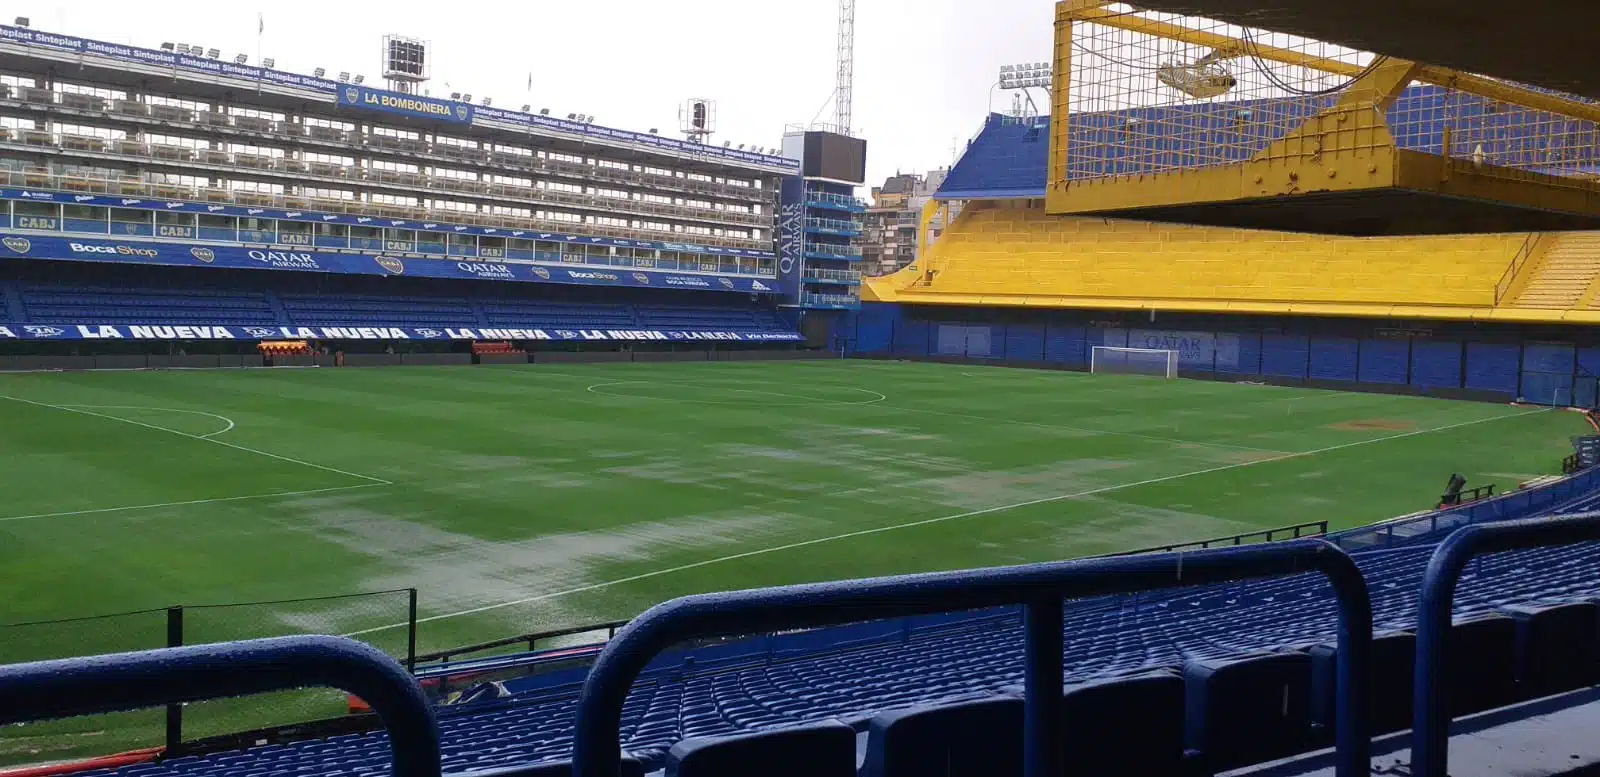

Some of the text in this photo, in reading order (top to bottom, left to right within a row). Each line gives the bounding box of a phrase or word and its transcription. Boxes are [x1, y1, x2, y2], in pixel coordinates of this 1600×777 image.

[35, 33, 82, 48] Sinteplast
[87, 42, 131, 55] Sinteplast
[133, 50, 176, 63] Sinteplast
[180, 57, 220, 70] Sinteplast
[222, 64, 260, 76] Sinteplast
[264, 71, 301, 83] Sinteplast
[302, 78, 337, 90] Sinteplast
[364, 92, 379, 105] LA
[381, 95, 451, 116] BOMBONERA
[20, 217, 56, 229] CABJ
[160, 225, 191, 237] CABJ
[792, 203, 801, 256] AIRWAYS
[281, 233, 309, 244] CABJ
[780, 203, 795, 274] QATAR
[387, 241, 411, 251] CABJ
[248, 250, 315, 263] QATAR
[481, 248, 502, 257] CABJ
[272, 260, 320, 269] AIRWAYS
[457, 261, 511, 273] QATAR
[76, 325, 236, 339] LA NUEVA
[279, 326, 319, 339] LA
[320, 326, 410, 339] NUEVA
[444, 328, 478, 339] LA
[478, 328, 552, 340] NUEVA
[579, 329, 669, 340] LA NUEVA
[681, 331, 742, 340] LA NUEVA
[1147, 335, 1200, 350] QATAR
